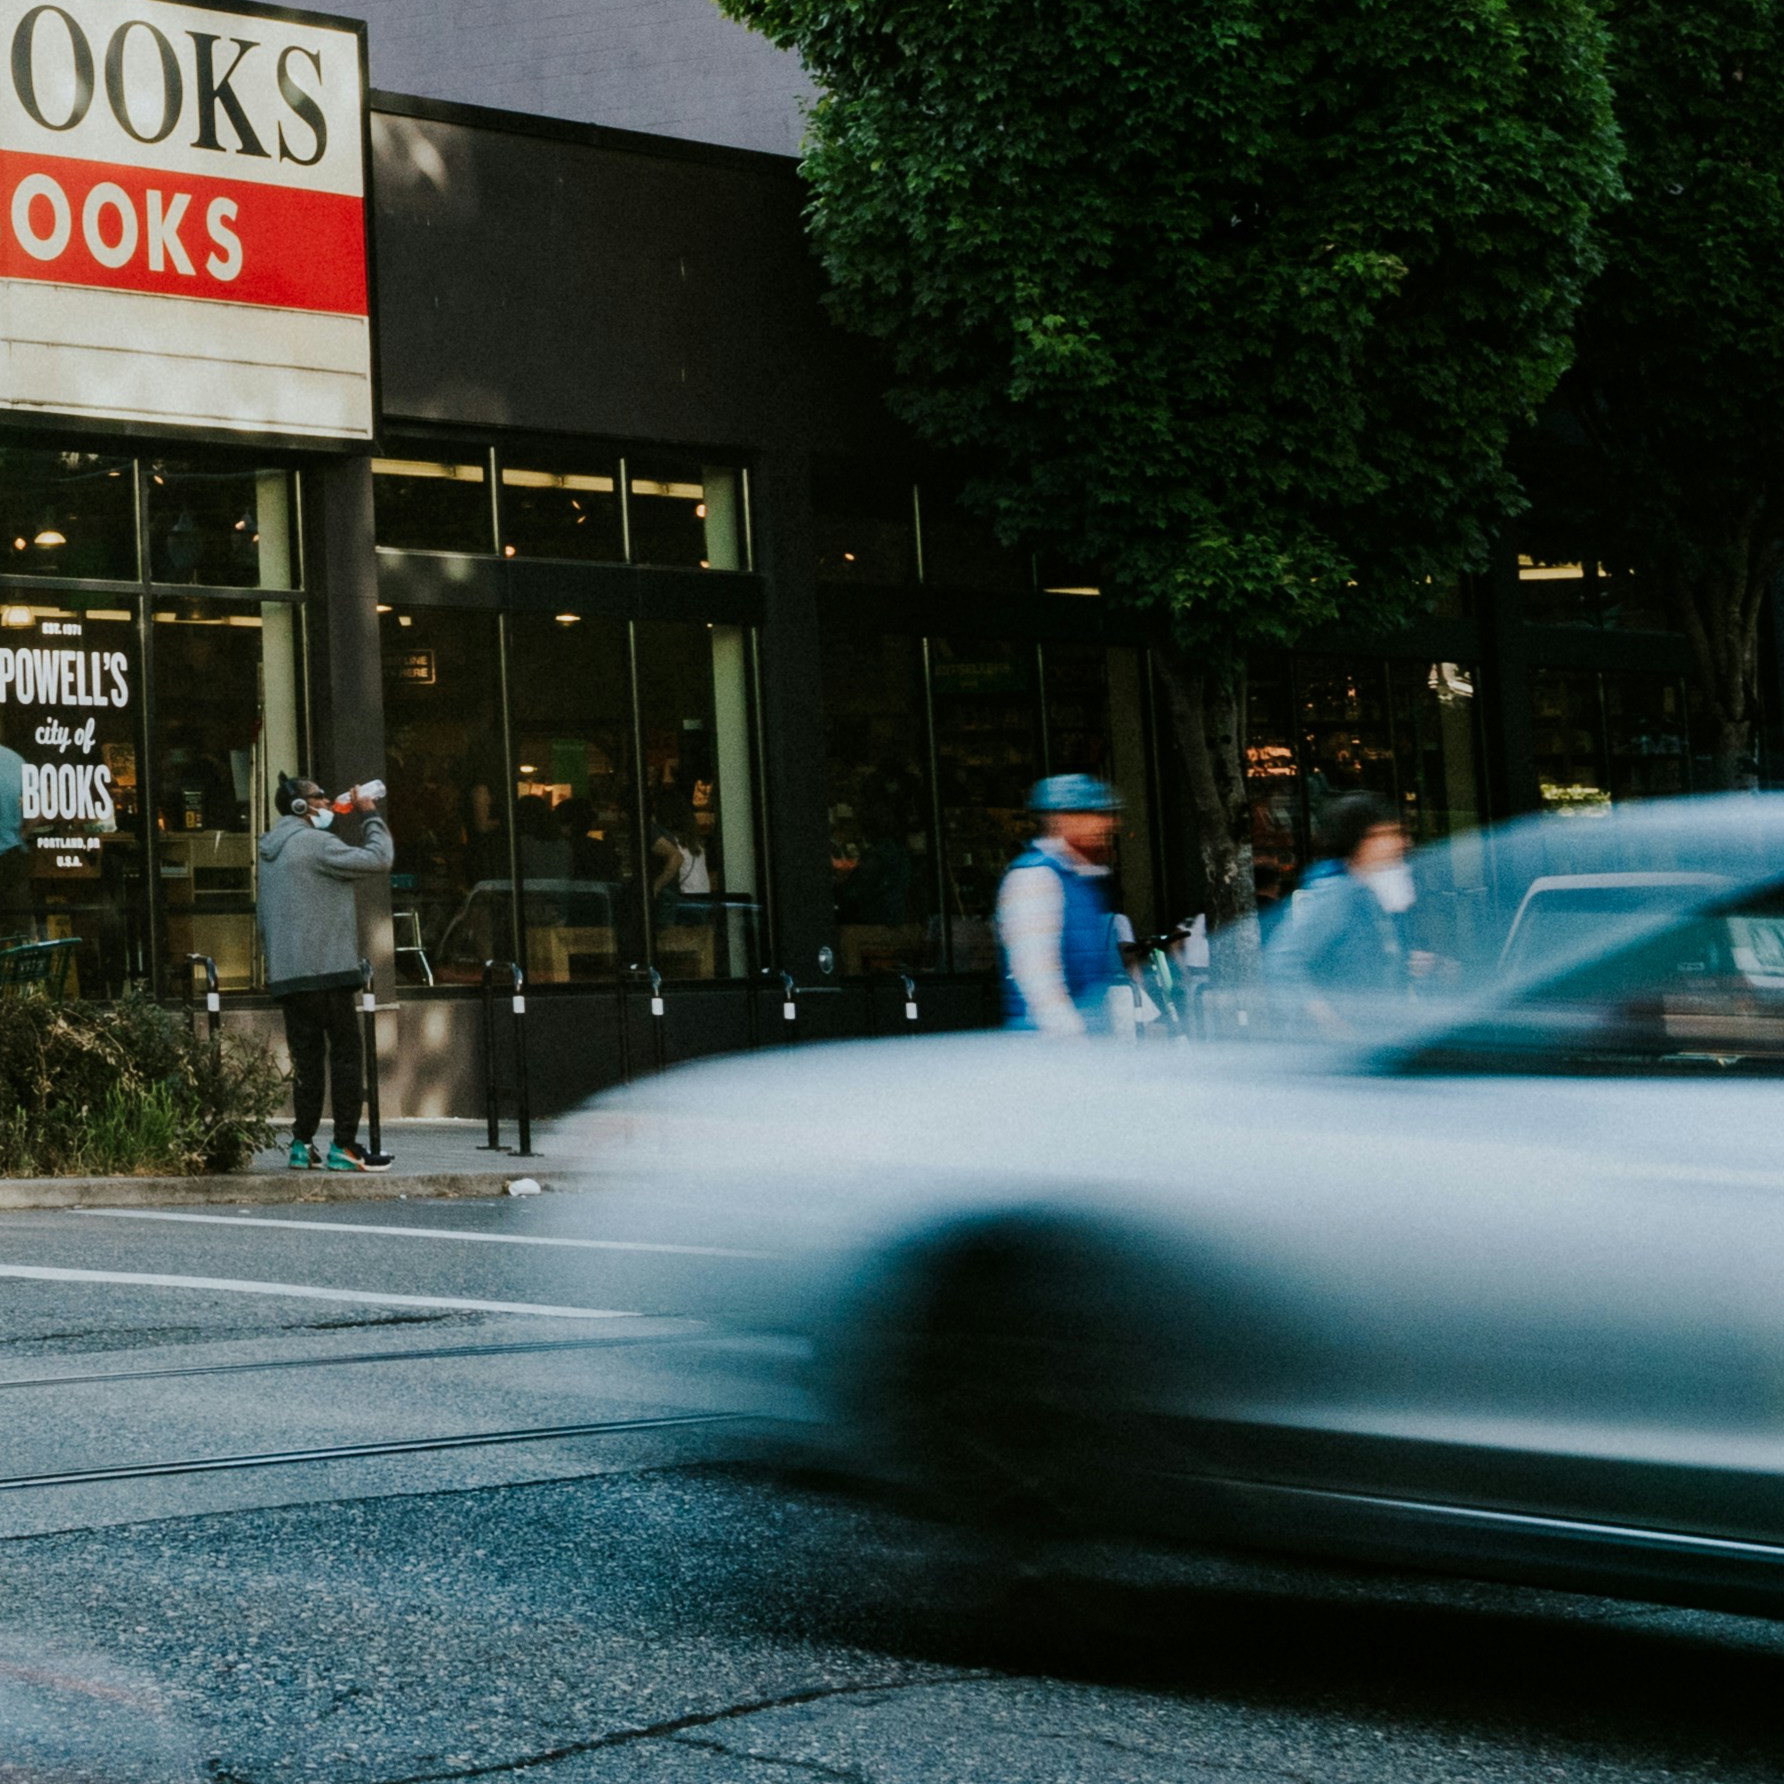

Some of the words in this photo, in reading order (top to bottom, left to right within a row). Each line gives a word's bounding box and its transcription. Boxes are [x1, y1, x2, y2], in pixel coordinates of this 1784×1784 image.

[34, 716, 72, 754] city
[73, 717, 96, 755] of
[21, 762, 113, 821] BOOKS
